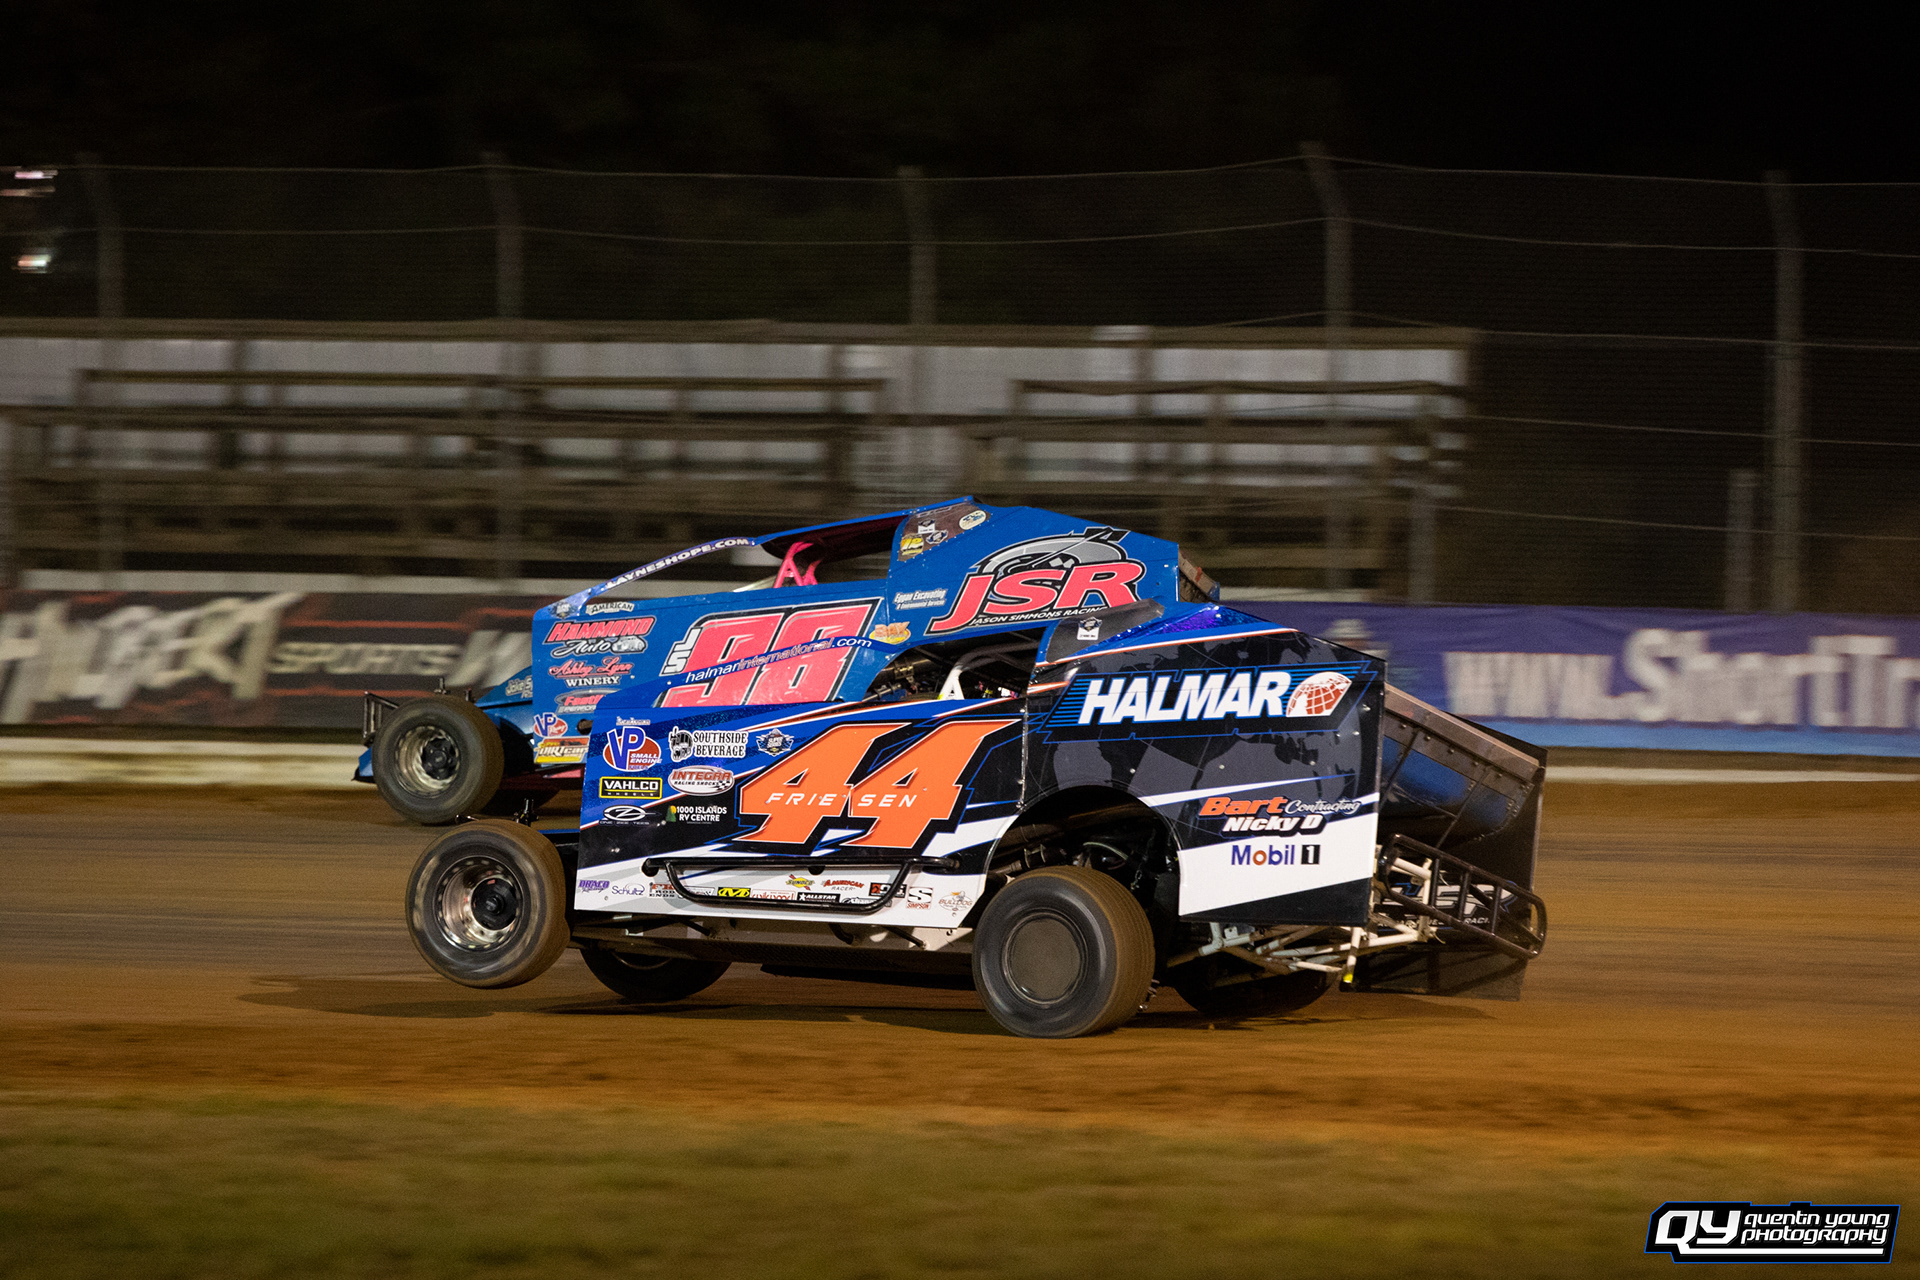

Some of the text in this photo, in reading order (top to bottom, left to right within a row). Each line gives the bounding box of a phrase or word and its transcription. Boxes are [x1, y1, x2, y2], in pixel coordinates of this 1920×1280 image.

[605, 538, 749, 589] LAYNESHOPE.COM
[930, 562, 1143, 632] JSR
[969, 615, 1006, 627] JASON
[1009, 610, 1061, 622] SIMMONS
[546, 617, 655, 642] HAMMOND
[553, 639, 612, 656] Auto
[686, 636, 873, 683] halmarinternational.com
[565, 676, 620, 688] WINERY
[1077, 671, 1293, 725] HALMAR
[534, 712, 556, 736] VP
[694, 731, 748, 744] SOUTHSIDE
[607, 726, 646, 771] VP
[695, 745, 746, 757] BEVERAGE
[672, 771, 731, 781] INTEGRA
[732, 718, 1022, 849] 44
[604, 780, 659, 791] VAHLCO
[766, 792, 918, 808] FRIESEN
[1199, 796, 1361, 816] Bart Contracting
[677, 805, 728, 815] 1000 ISLANDS
[690, 814, 720, 822] CENTRE
[1222, 814, 1324, 833] Nicky D
[1231, 844, 1295, 866] Mobil
[785, 878, 815, 887] SUNOCO
[805, 893, 838, 901] ALLSTAR
